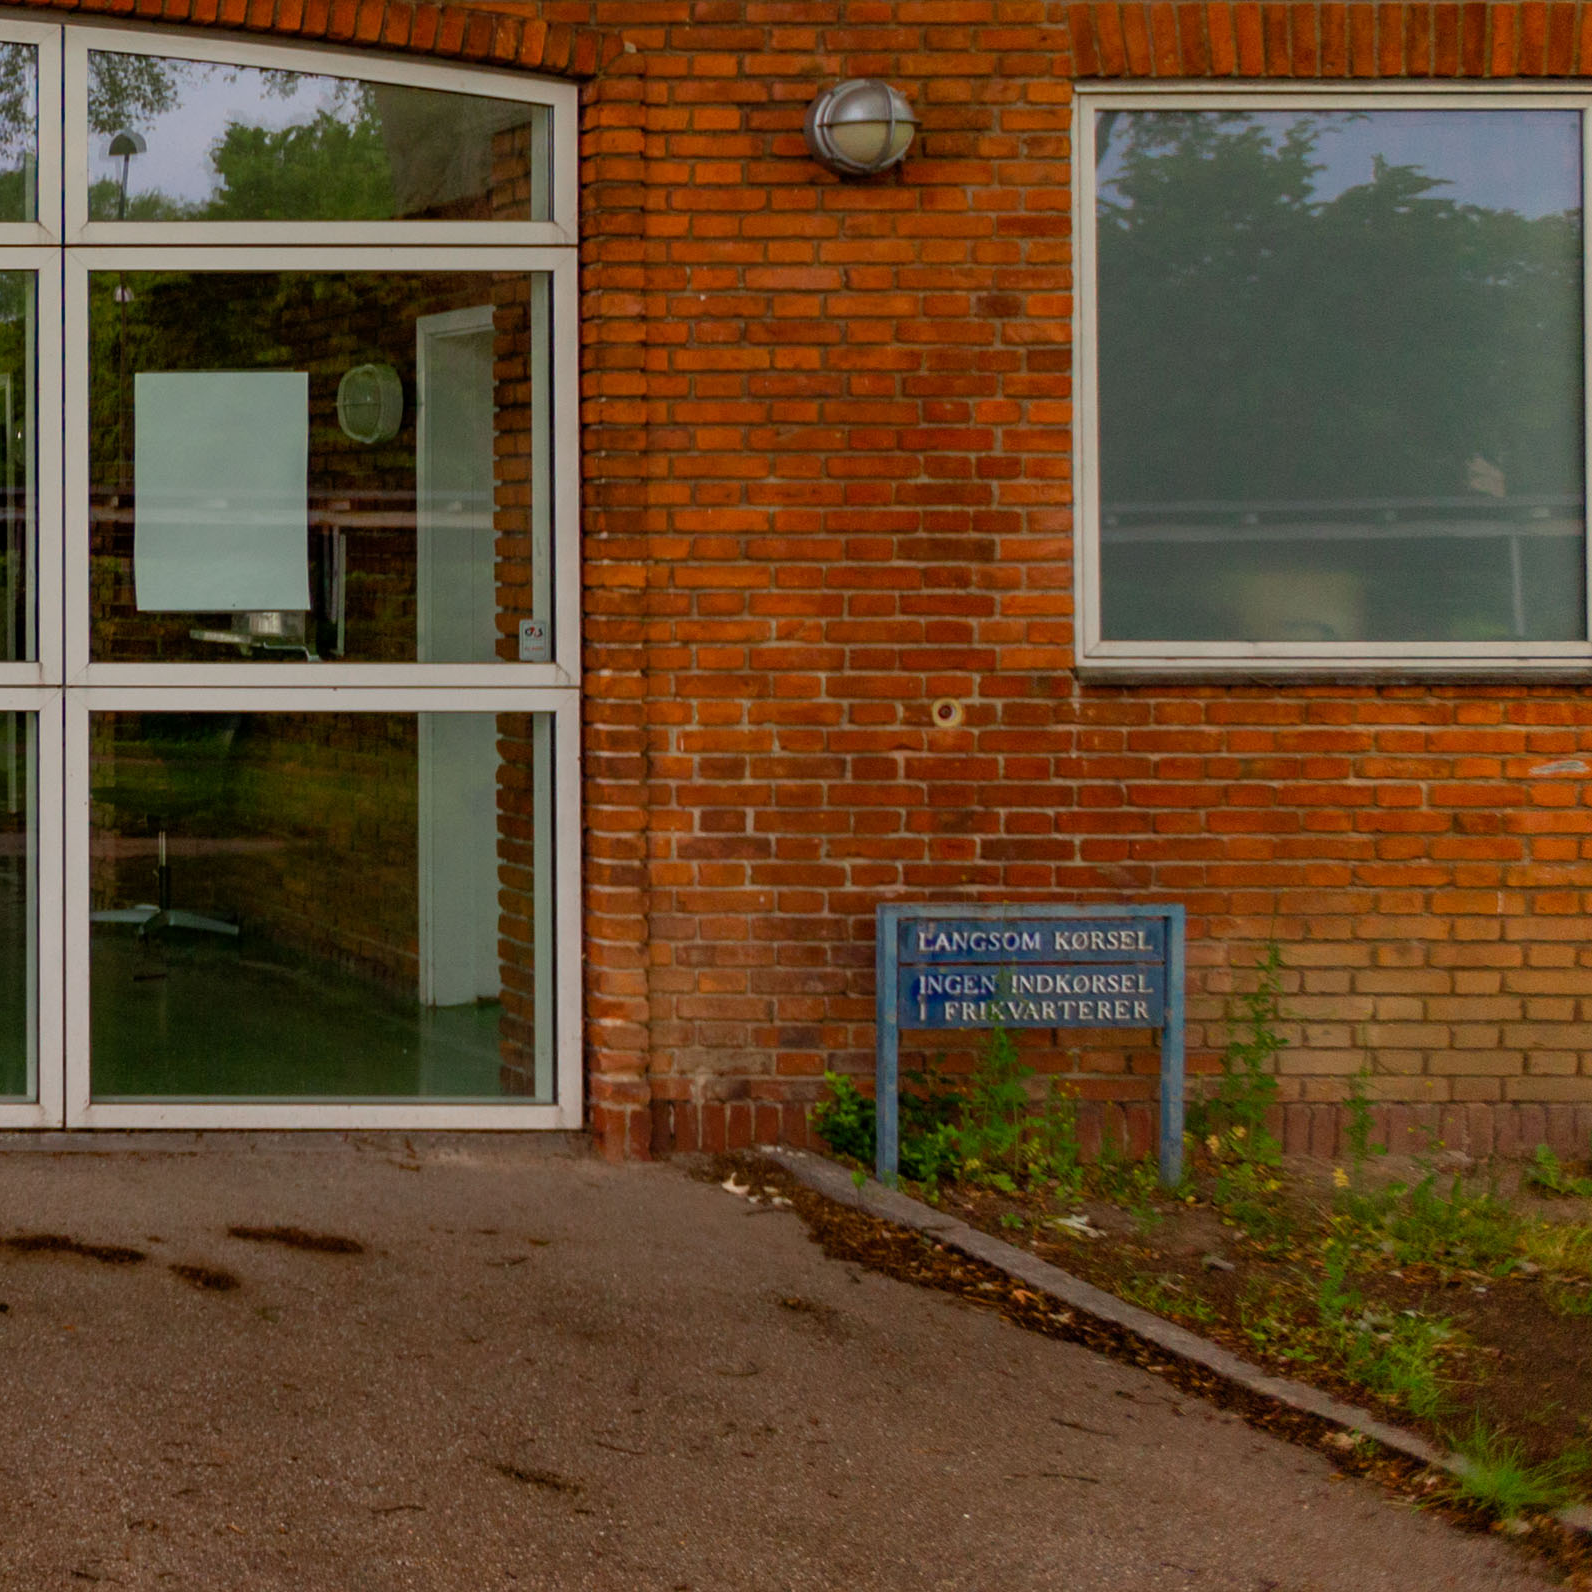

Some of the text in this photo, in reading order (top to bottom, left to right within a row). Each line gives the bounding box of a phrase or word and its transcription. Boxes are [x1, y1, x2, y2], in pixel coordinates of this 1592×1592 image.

[918, 930, 1154, 952] LANGSOM KØRSEL
[919, 974, 1154, 996] INGEN INDKØRSEL
[918, 1000, 1150, 1022] I FRIKVARTERER
